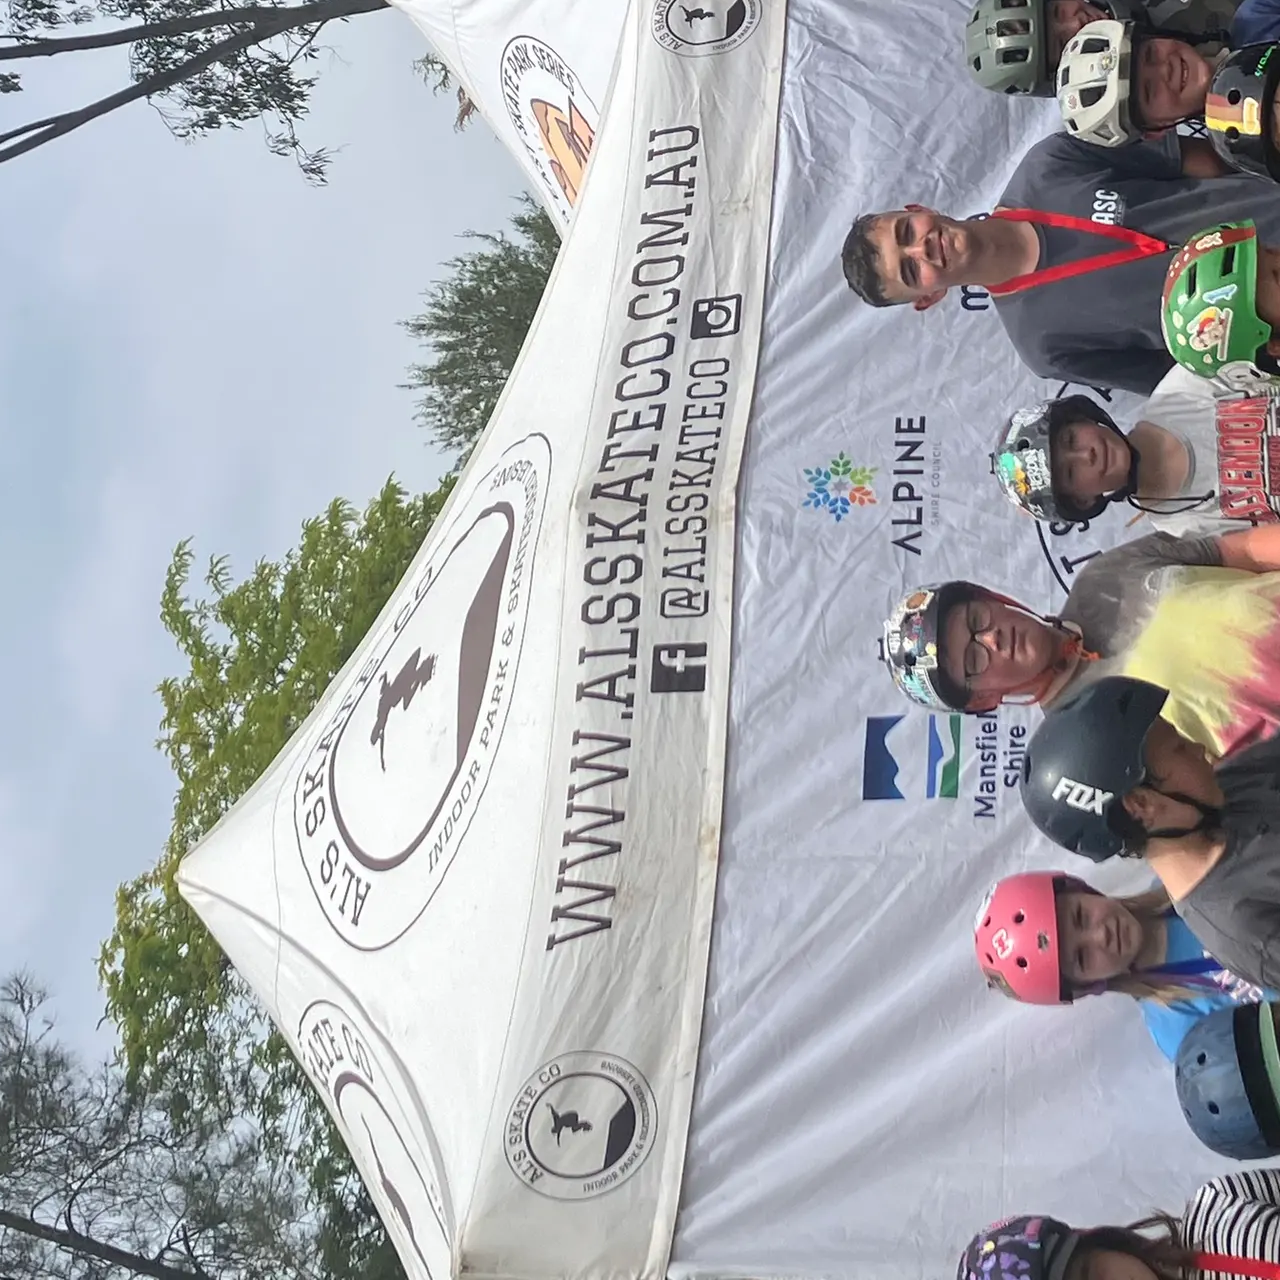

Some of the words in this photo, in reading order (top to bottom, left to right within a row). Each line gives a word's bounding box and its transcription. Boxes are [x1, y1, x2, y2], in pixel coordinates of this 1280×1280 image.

[506, 42, 537, 80] PARK
[658, 32, 684, 51] AL'S
[503, 72, 528, 137] SKATE
[1090, 188, 1119, 225] ASC
[658, 357, 731, 619] @ALSSKATECO
[890, 415, 926, 557] ALPINE
[545, 124, 700, 951] WWW.ALSSKATECO.COM.AU
[301, 657, 380, 838] SKATE
[427, 759, 482, 875] INDOOR
[478, 658, 510, 751] PARK
[502, 622, 516, 647] &
[973, 708, 998, 819] Mansfiel
[1051, 776, 1115, 816] FOX
[319, 839, 372, 927] AL'S
[537, 1063, 562, 1085] CO
[508, 1085, 538, 1147] SKATE
[512, 1149, 544, 1184] AL'S
